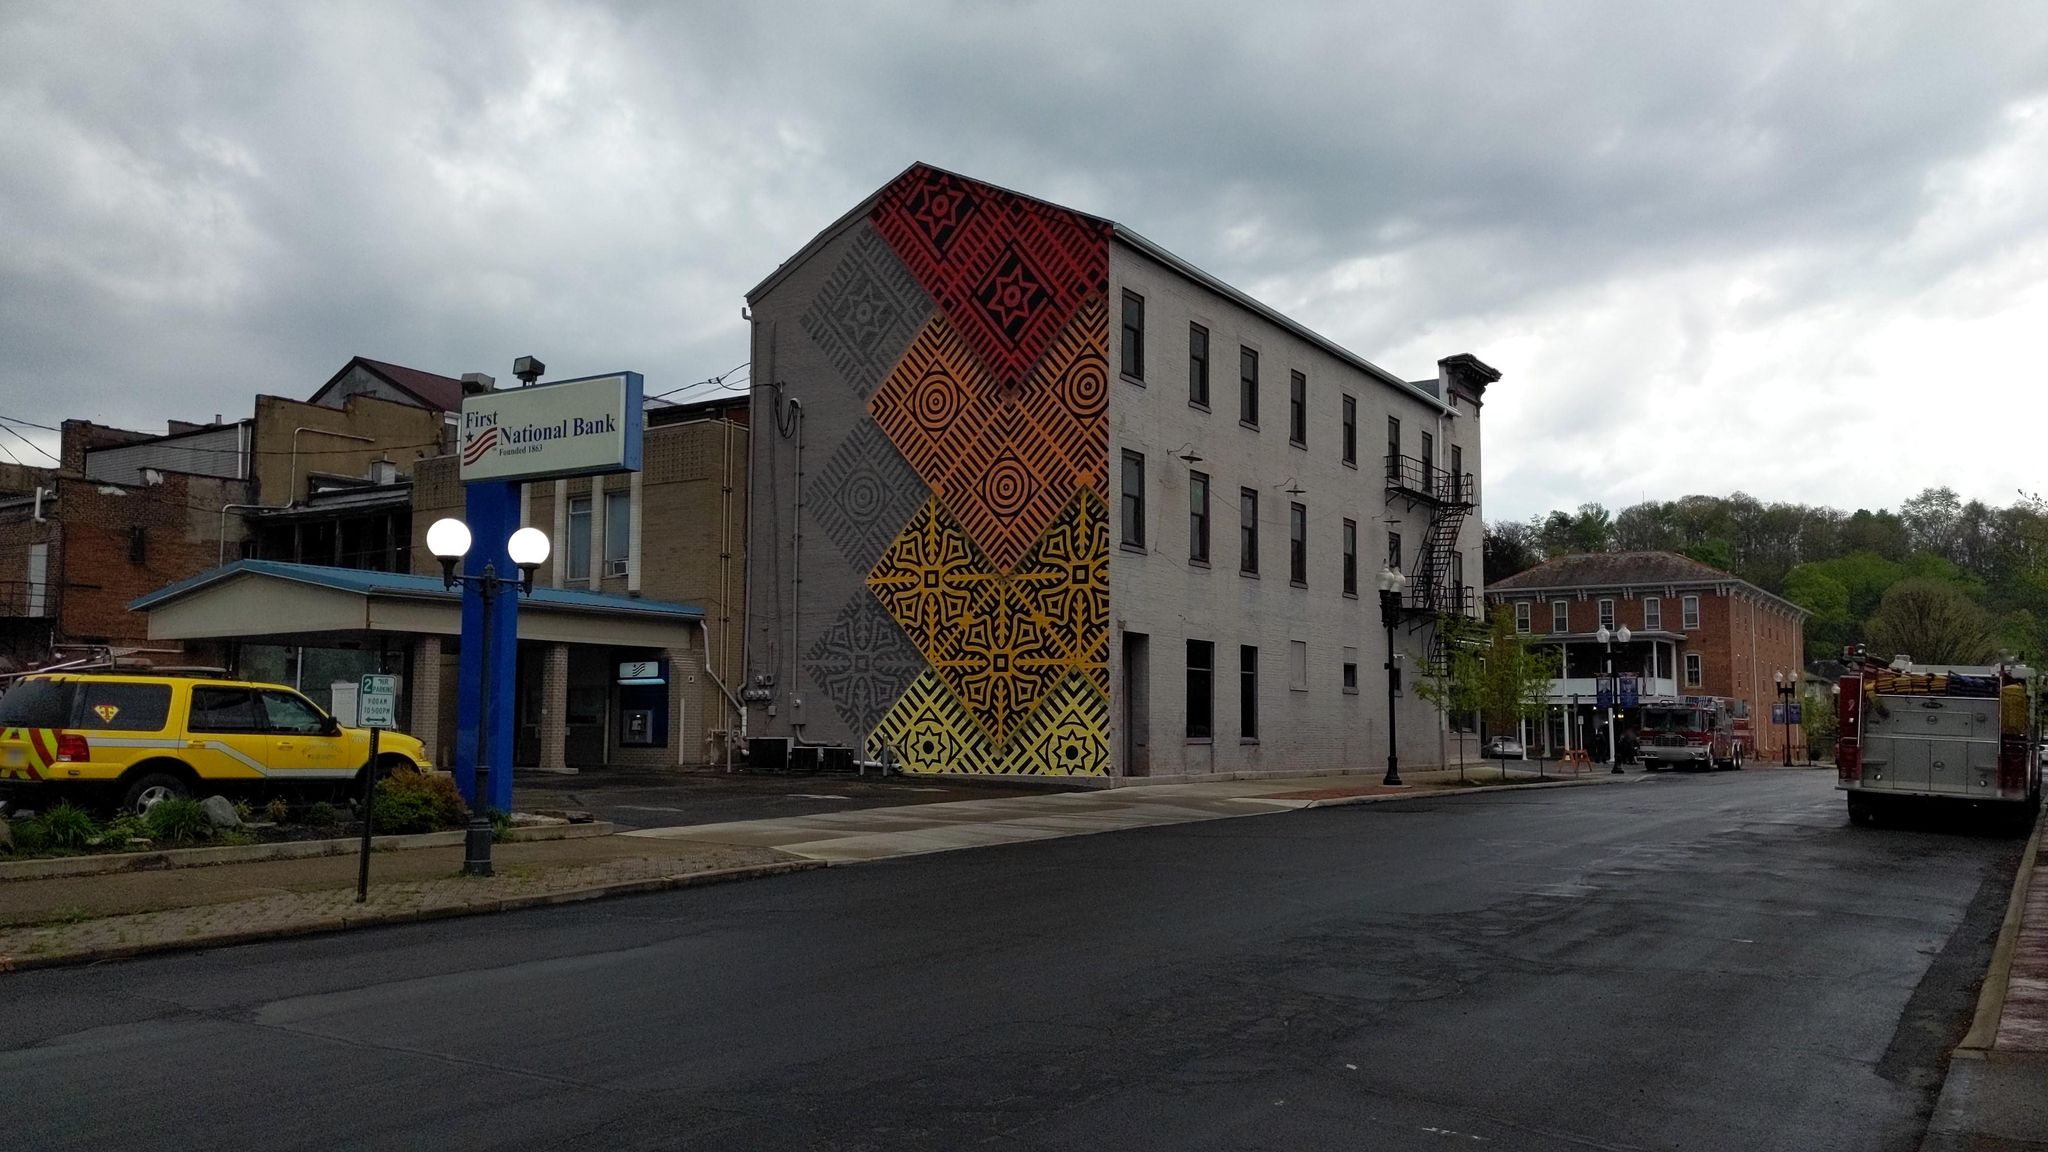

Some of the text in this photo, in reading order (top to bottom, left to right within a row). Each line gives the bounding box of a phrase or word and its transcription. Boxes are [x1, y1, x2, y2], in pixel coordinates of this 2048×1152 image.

[466, 410, 498, 429] First
[500, 413, 616, 446] National Bank
[499, 443, 543, 457] Founded 1863
[364, 678, 372, 692] 2
[372, 685, 393, 693] PARKING
